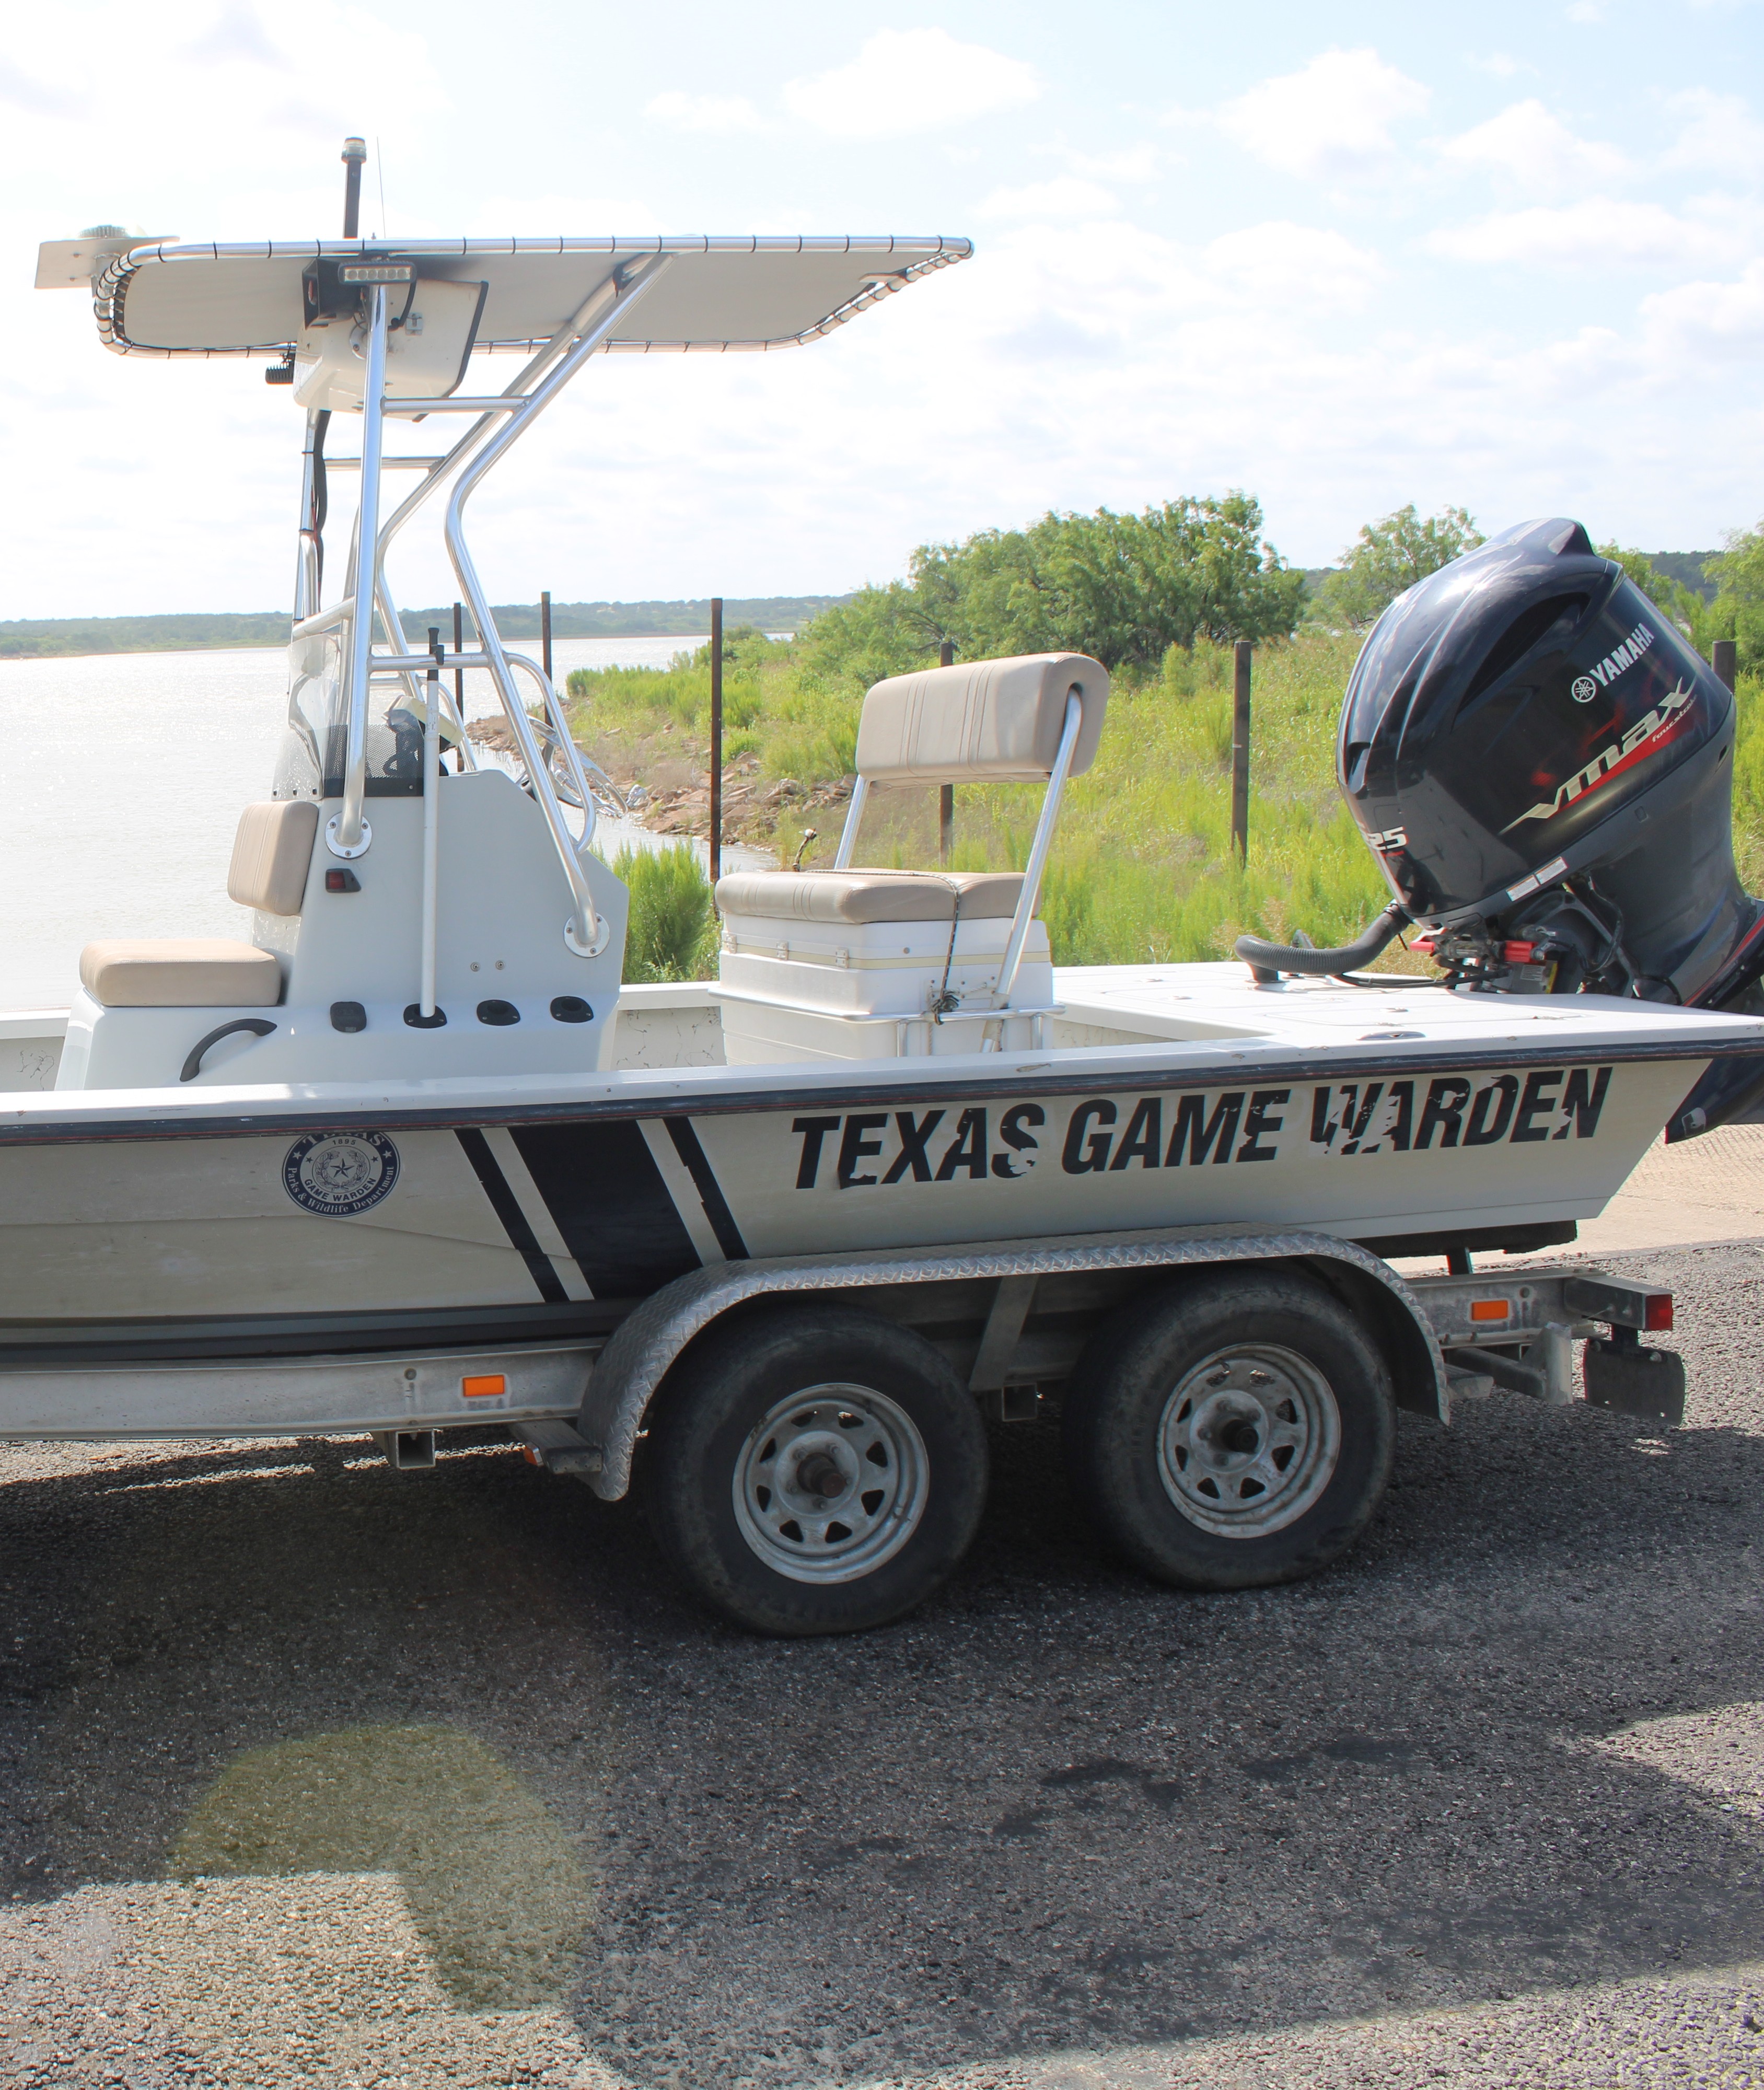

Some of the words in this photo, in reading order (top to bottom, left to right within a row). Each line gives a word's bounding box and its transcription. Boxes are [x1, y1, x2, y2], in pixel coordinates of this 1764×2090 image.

[1589, 623, 1655, 687] YAMAHA
[791, 1102, 1045, 1189] TEXAS
[1062, 1089, 1291, 1175] GAME
[1309, 1066, 1612, 1155] WARDEN
[288, 1168, 299, 1192] Parks
[307, 1198, 349, 1213] Wildlife
[353, 1166, 394, 1210] Department
[305, 1179, 329, 1200] GAME
[333, 1178, 376, 1202] WARDEN
